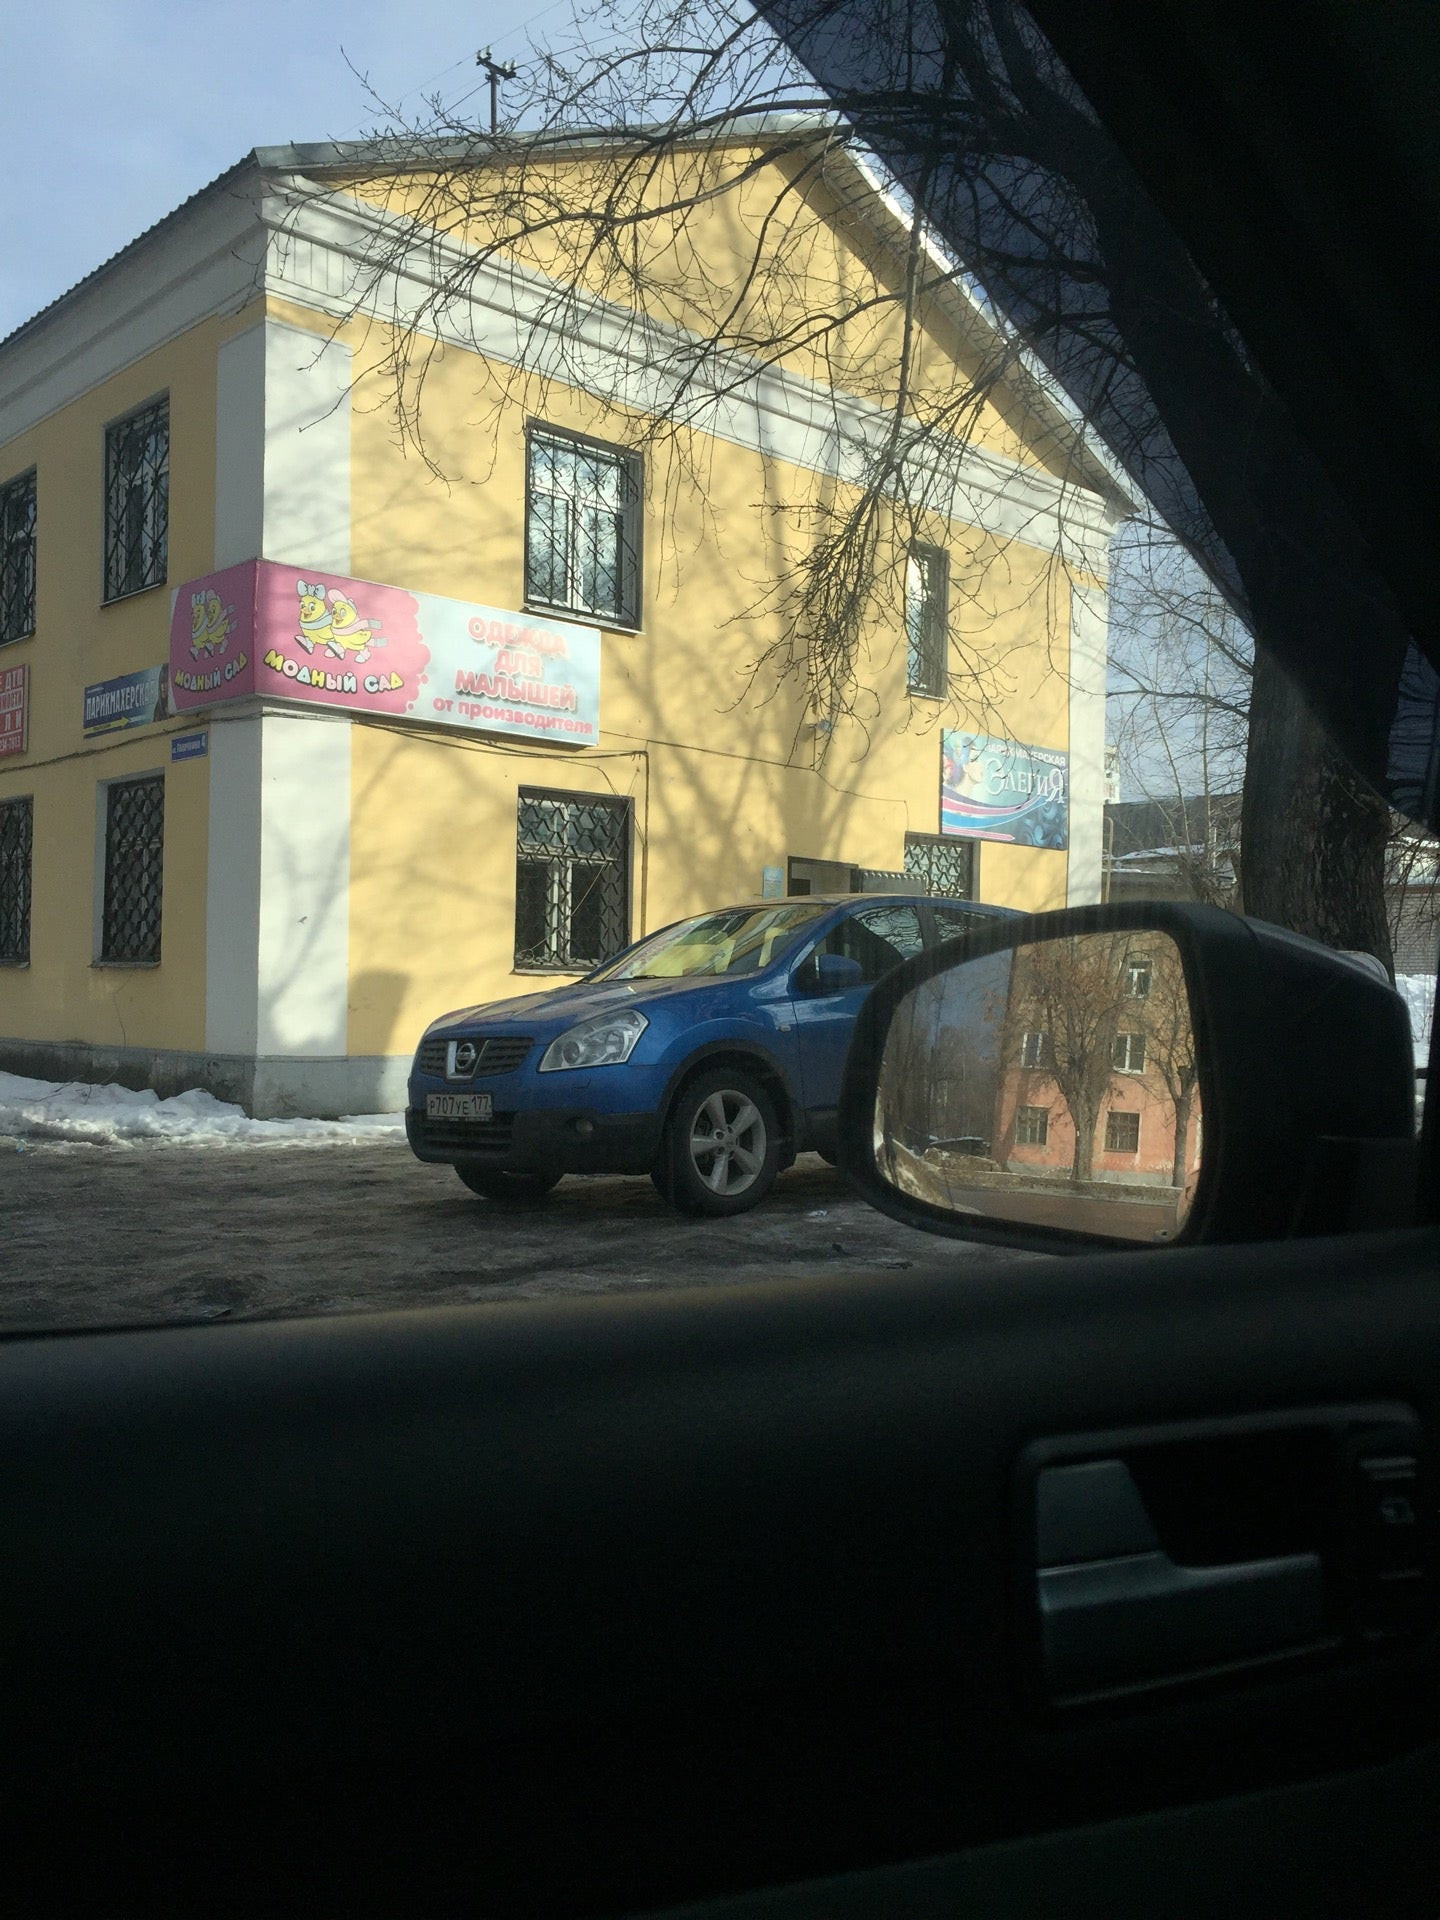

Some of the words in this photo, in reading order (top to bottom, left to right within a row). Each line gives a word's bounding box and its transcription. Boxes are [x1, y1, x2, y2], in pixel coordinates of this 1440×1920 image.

[468, 617, 571, 657] ОДЕЖДА
[174, 666, 222, 693] МОДНЫЙ
[224, 652, 248, 682] САД
[263, 648, 358, 694] МОДНЫЙ
[363, 671, 405, 692] САД
[494, 649, 543, 677] ДЛЯ
[455, 669, 579, 712] МАЛЫШЕЙ
[432, 697, 455, 713] от
[458, 700, 594, 735] производителя
[472, 1095, 489, 1113] 177
